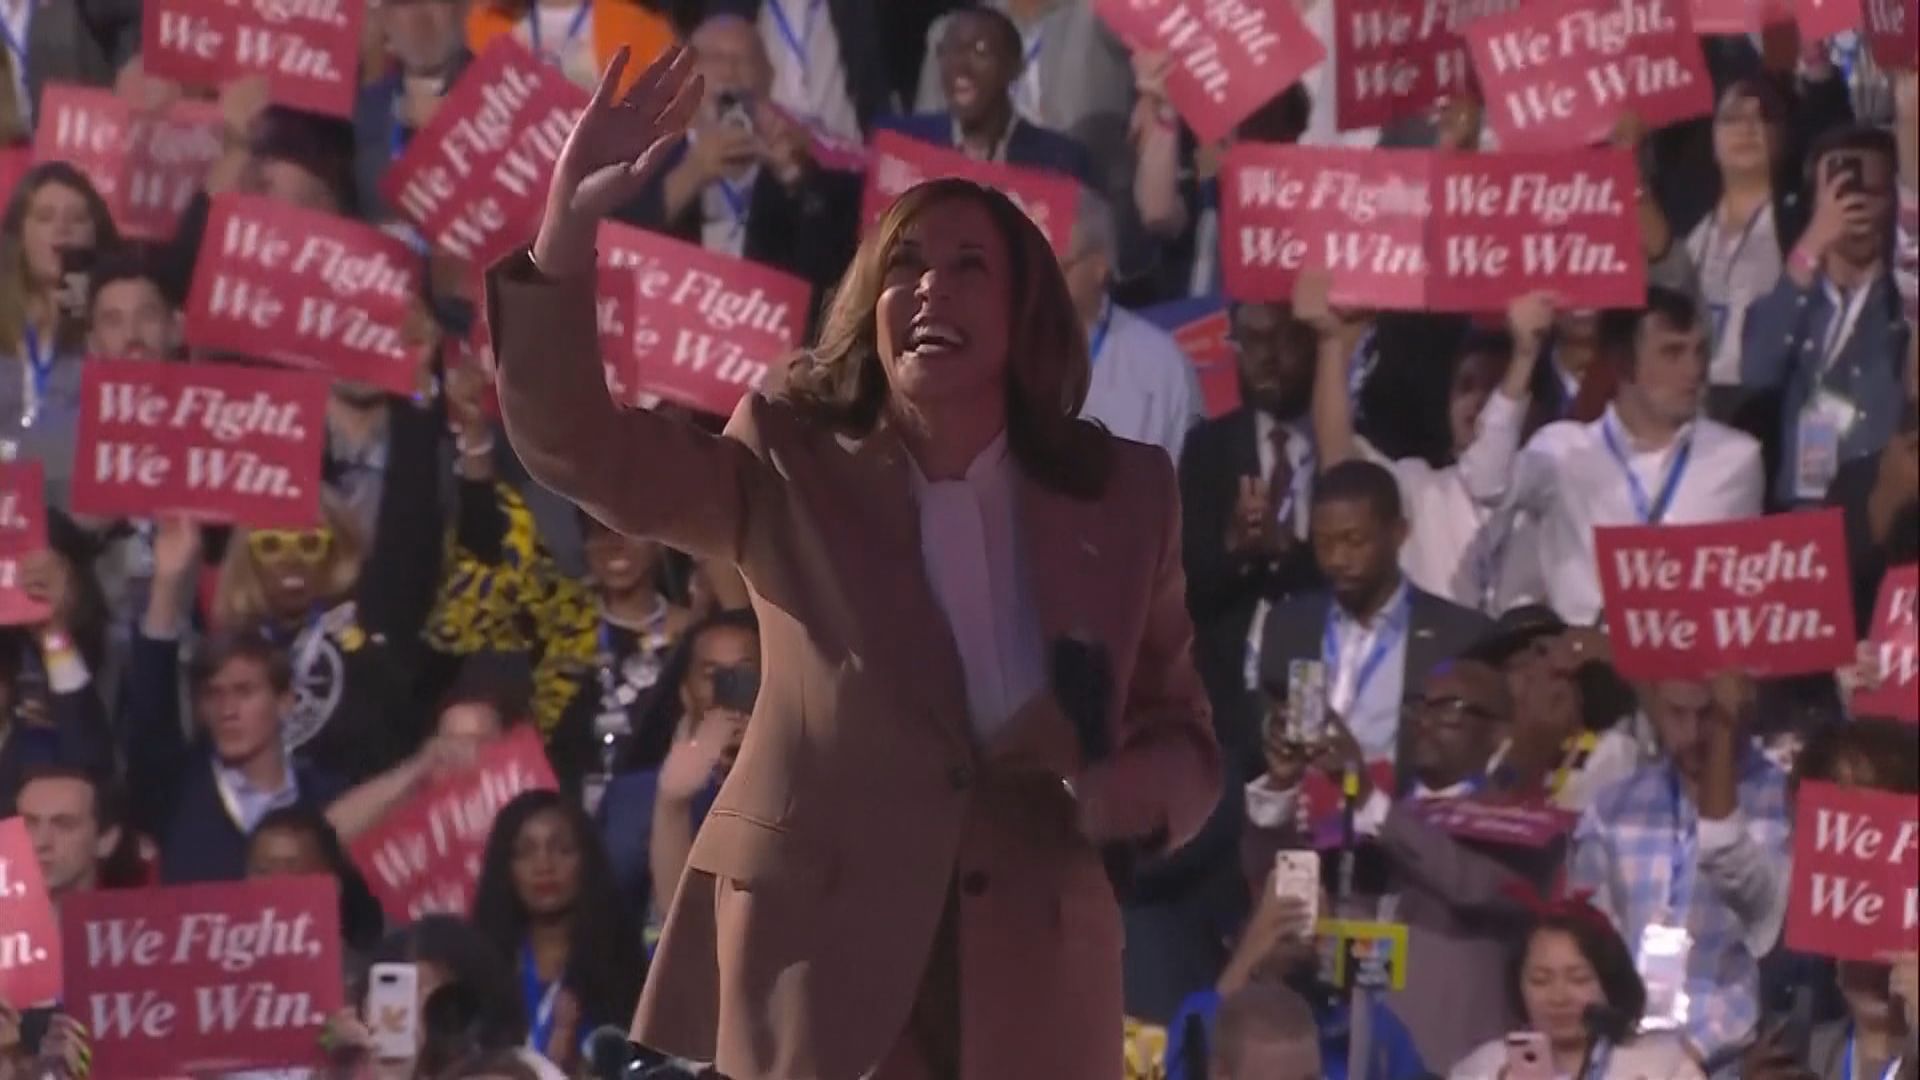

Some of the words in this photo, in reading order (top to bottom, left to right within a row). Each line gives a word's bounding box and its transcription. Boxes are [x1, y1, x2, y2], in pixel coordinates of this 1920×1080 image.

[160, 11, 224, 58] We
[236, 26, 341, 82] Win.
[1352, 11, 1411, 48] We
[1487, 27, 1550, 74] We
[1355, 62, 1419, 100] We
[1506, 81, 1577, 129] We
[1586, 54, 1693, 106] Win.
[400, 164, 456, 225] We
[1239, 167, 1303, 211] We
[1445, 174, 1502, 218] We
[1505, 172, 1624, 225] Fight,
[222, 215, 291, 269] We
[436, 195, 505, 262] We
[1240, 227, 1308, 271] We
[1446, 235, 1508, 277] We
[1522, 231, 1628, 277] Win.
[208, 275, 284, 328] We
[298, 296, 408, 360] Win.
[672, 267, 792, 342] Fight,
[96, 382, 168, 426] We
[170, 385, 308, 442] Fight,
[94, 441, 170, 485] We
[186, 446, 303, 497] Win.
[1613, 547, 1682, 592] We
[1688, 540, 1830, 598] Fight,
[1624, 607, 1698, 651] We
[1712, 602, 1838, 650] Win.
[1815, 808, 1884, 859] We
[1811, 873, 1885, 926] We
[85, 918, 164, 969] We
[170, 907, 322, 972] Fight,
[90, 990, 176, 1041] We
[195, 982, 327, 1036] Win.
